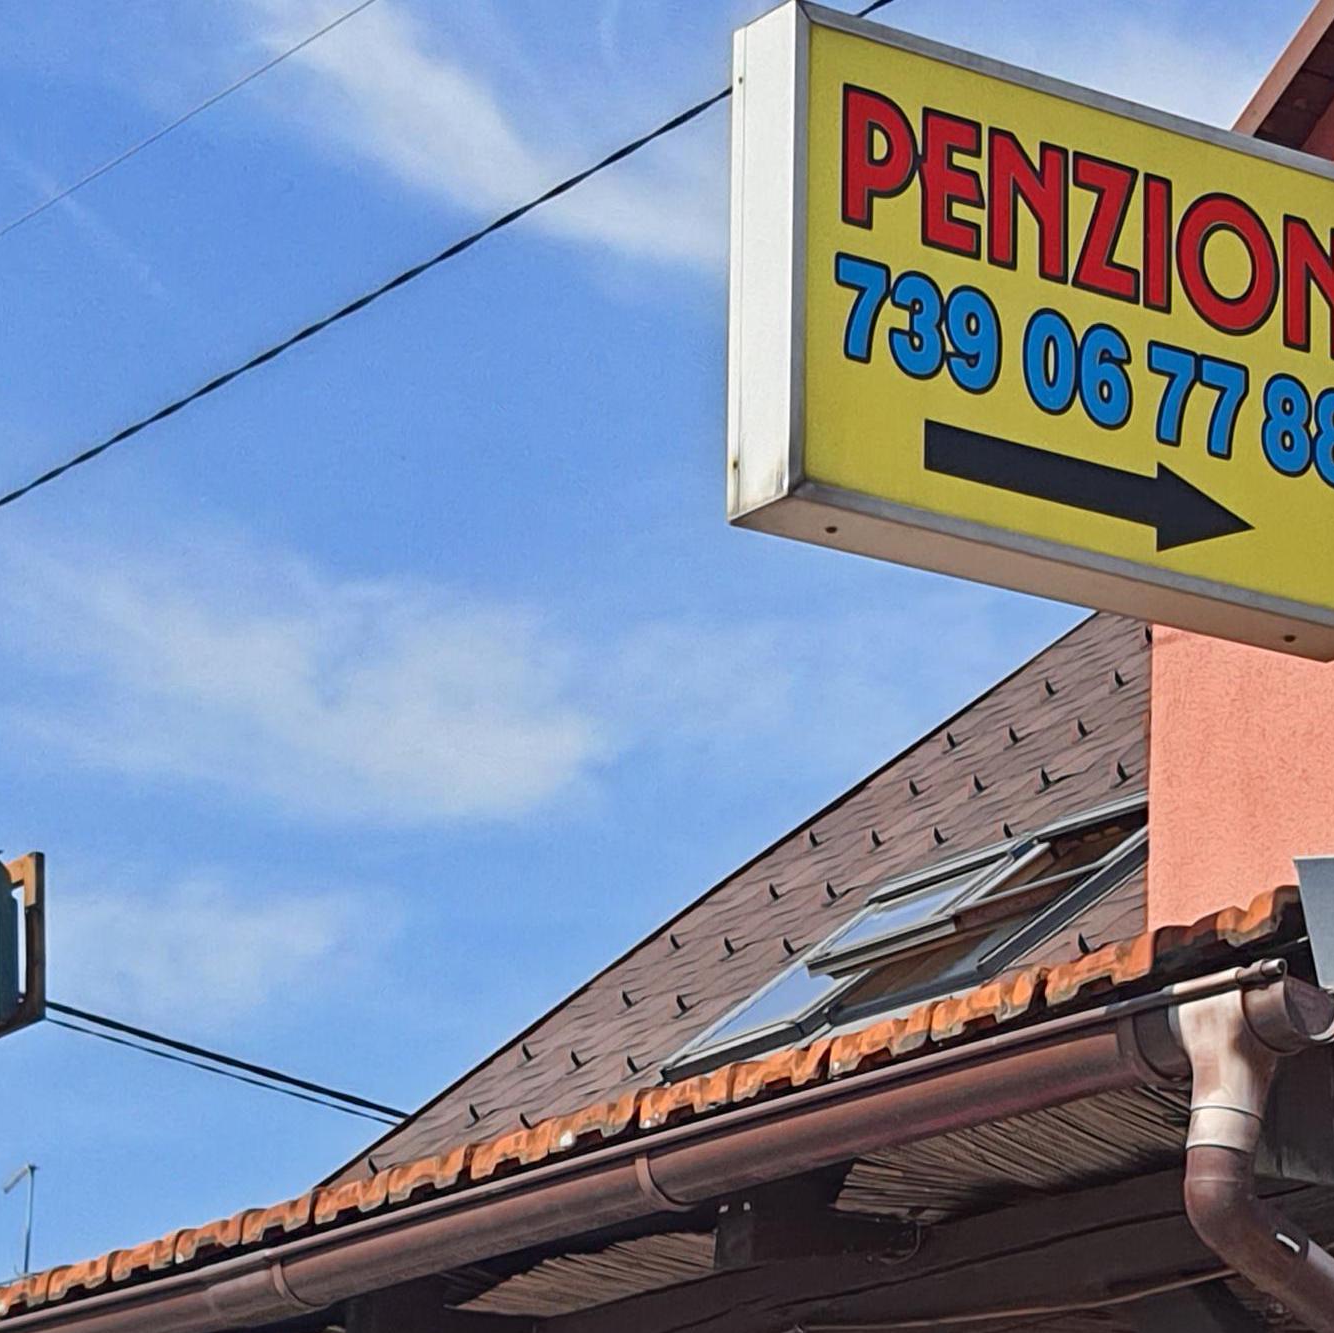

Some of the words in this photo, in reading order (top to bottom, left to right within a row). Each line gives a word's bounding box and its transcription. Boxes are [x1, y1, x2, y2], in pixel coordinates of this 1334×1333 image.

[835, 252, 1003, 395] 739
[1022, 307, 1133, 431] 06
[1147, 340, 1249, 460] 77
